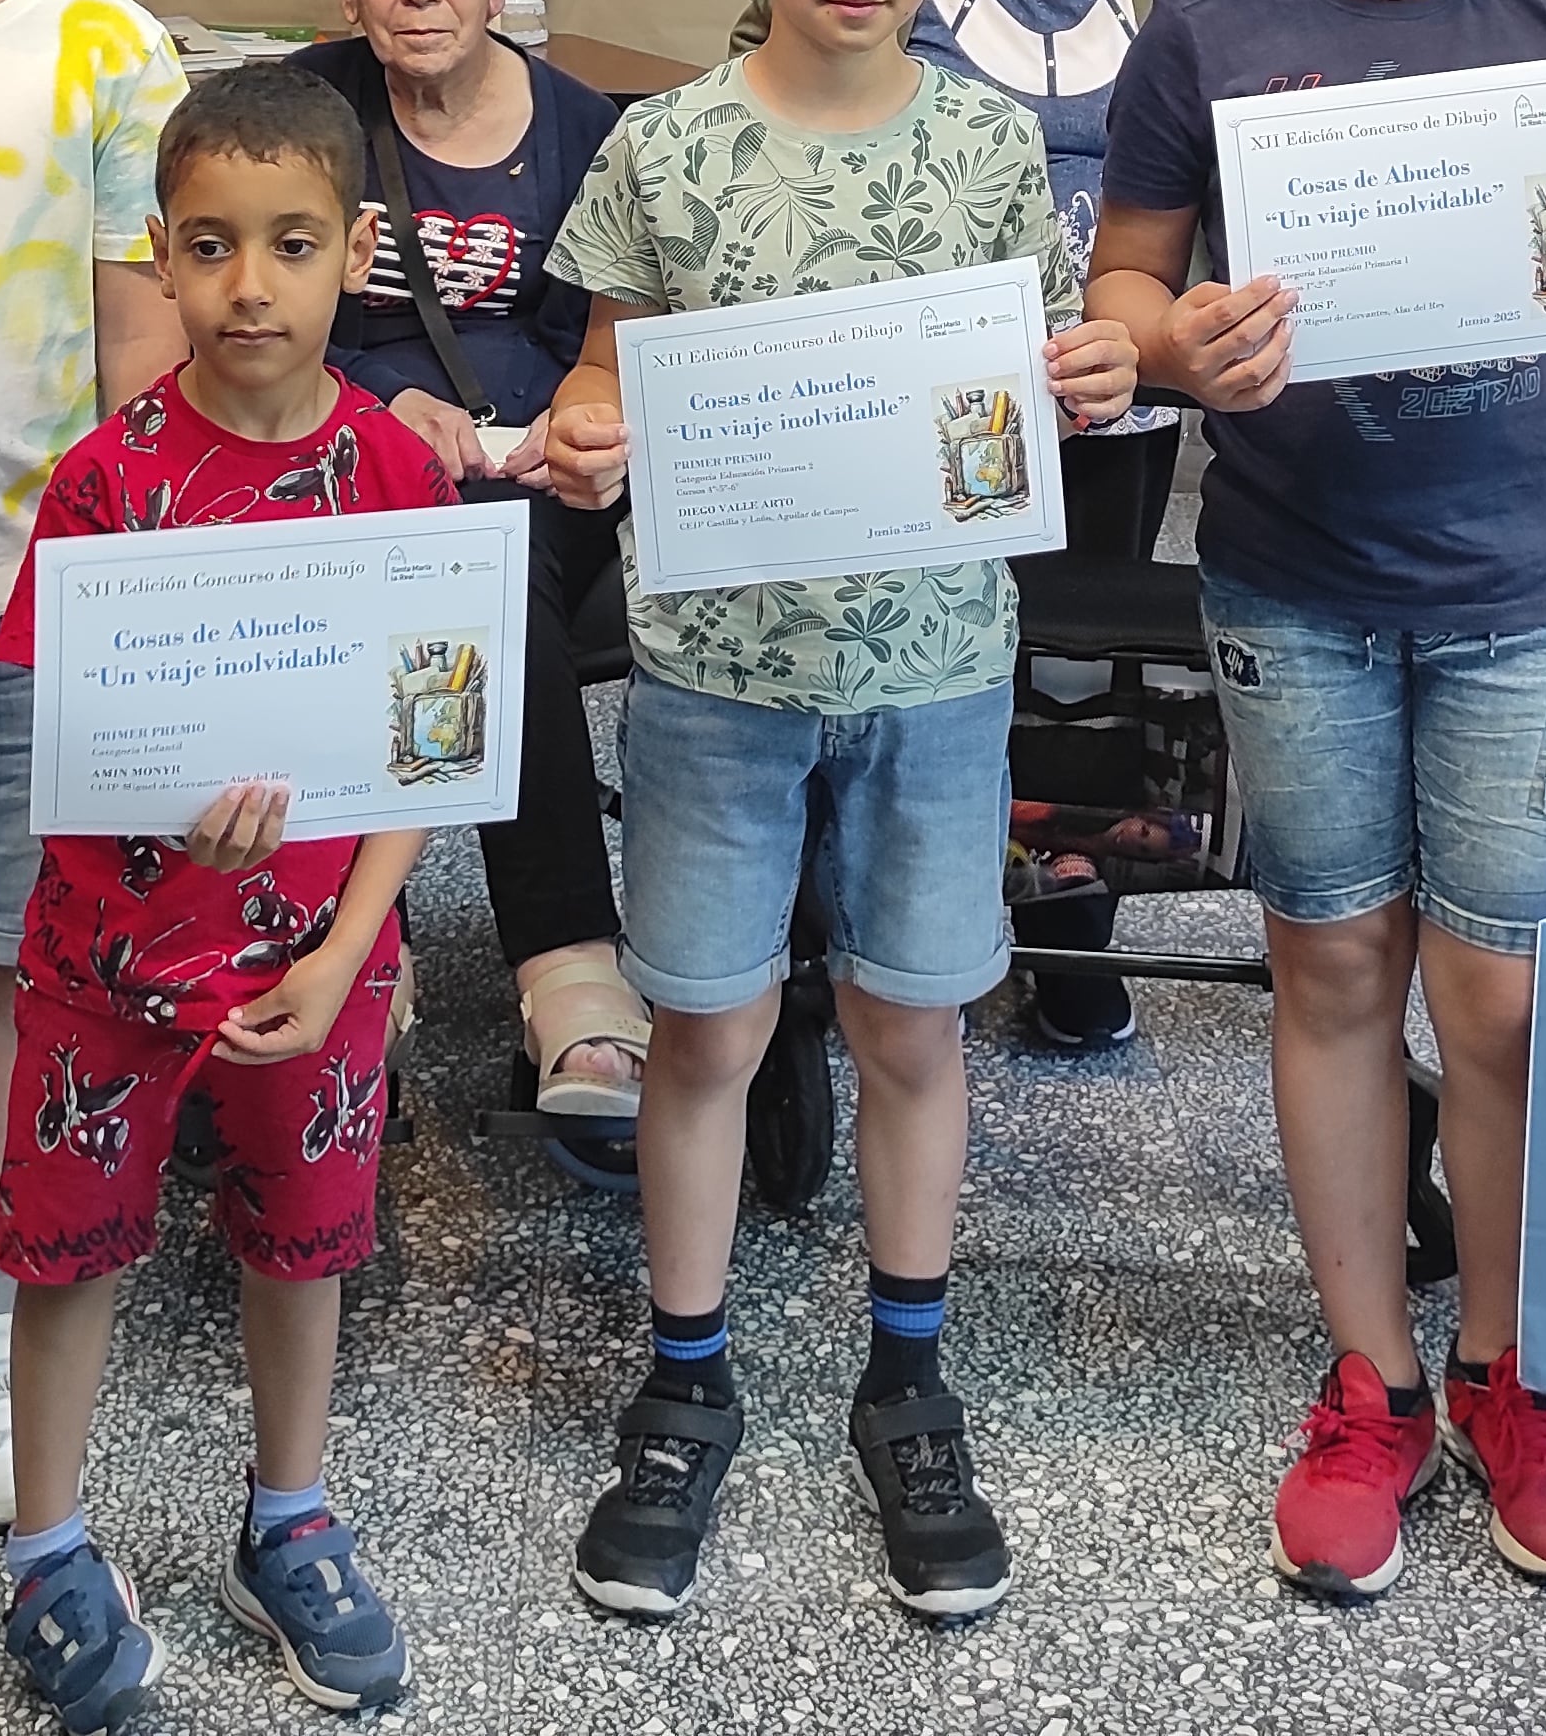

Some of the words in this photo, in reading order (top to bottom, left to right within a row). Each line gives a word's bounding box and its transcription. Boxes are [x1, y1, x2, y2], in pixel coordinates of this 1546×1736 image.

[1250, 133, 1281, 151] XII
[1285, 127, 1344, 147] Edición
[1349, 121, 1419, 138] Concurso
[1423, 115, 1441, 130] de
[1445, 109, 1497, 127] Dibujo
[1287, 176, 1348, 197] Cosas
[1354, 169, 1378, 189] de
[1384, 159, 1471, 186] Abuelos
[1317, 203, 1370, 228] viaje
[1273, 250, 1328, 267] SEGUNDO
[1330, 244, 1377, 260] PREMIO
[1457, 315, 1490, 329] Junio
[1493, 310, 1522, 324] 2025
[653, 352, 683, 368] XII
[689, 345, 748, 365] Edición
[753, 336, 824, 355] Concurso
[828, 330, 846, 344] de
[851, 322, 903, 340] Dibujo
[689, 392, 751, 412] Cosas
[758, 385, 782, 404] de
[789, 372, 876, 399] Abuelos
[719, 416, 774, 440] viaje
[674, 458, 722, 471] PRIMER
[724, 452, 772, 466] PREMIO
[678, 505, 716, 518] DIEGO
[718, 501, 758, 514] VALLE
[760, 497, 794, 510] ARTO
[811, 508, 822, 518] de
[866, 526, 901, 540] Junio
[903, 521, 932, 534] 2025
[77, 580, 110, 598] XII
[118, 575, 186, 595] Edición
[193, 571, 274, 589] Concurso
[280, 565, 299, 580] de
[306, 560, 365, 579] Dibujo
[114, 629, 184, 651] Cosas
[192, 623, 220, 643] de
[229, 614, 328, 641] Abuelos
[145, 659, 206, 686] viaje
[92, 727, 149, 742] PRIMER
[152, 722, 206, 737] PREMIO
[92, 767, 128, 778] AMIN
[298, 787, 336, 804] Junio
[341, 783, 372, 798] 2025
